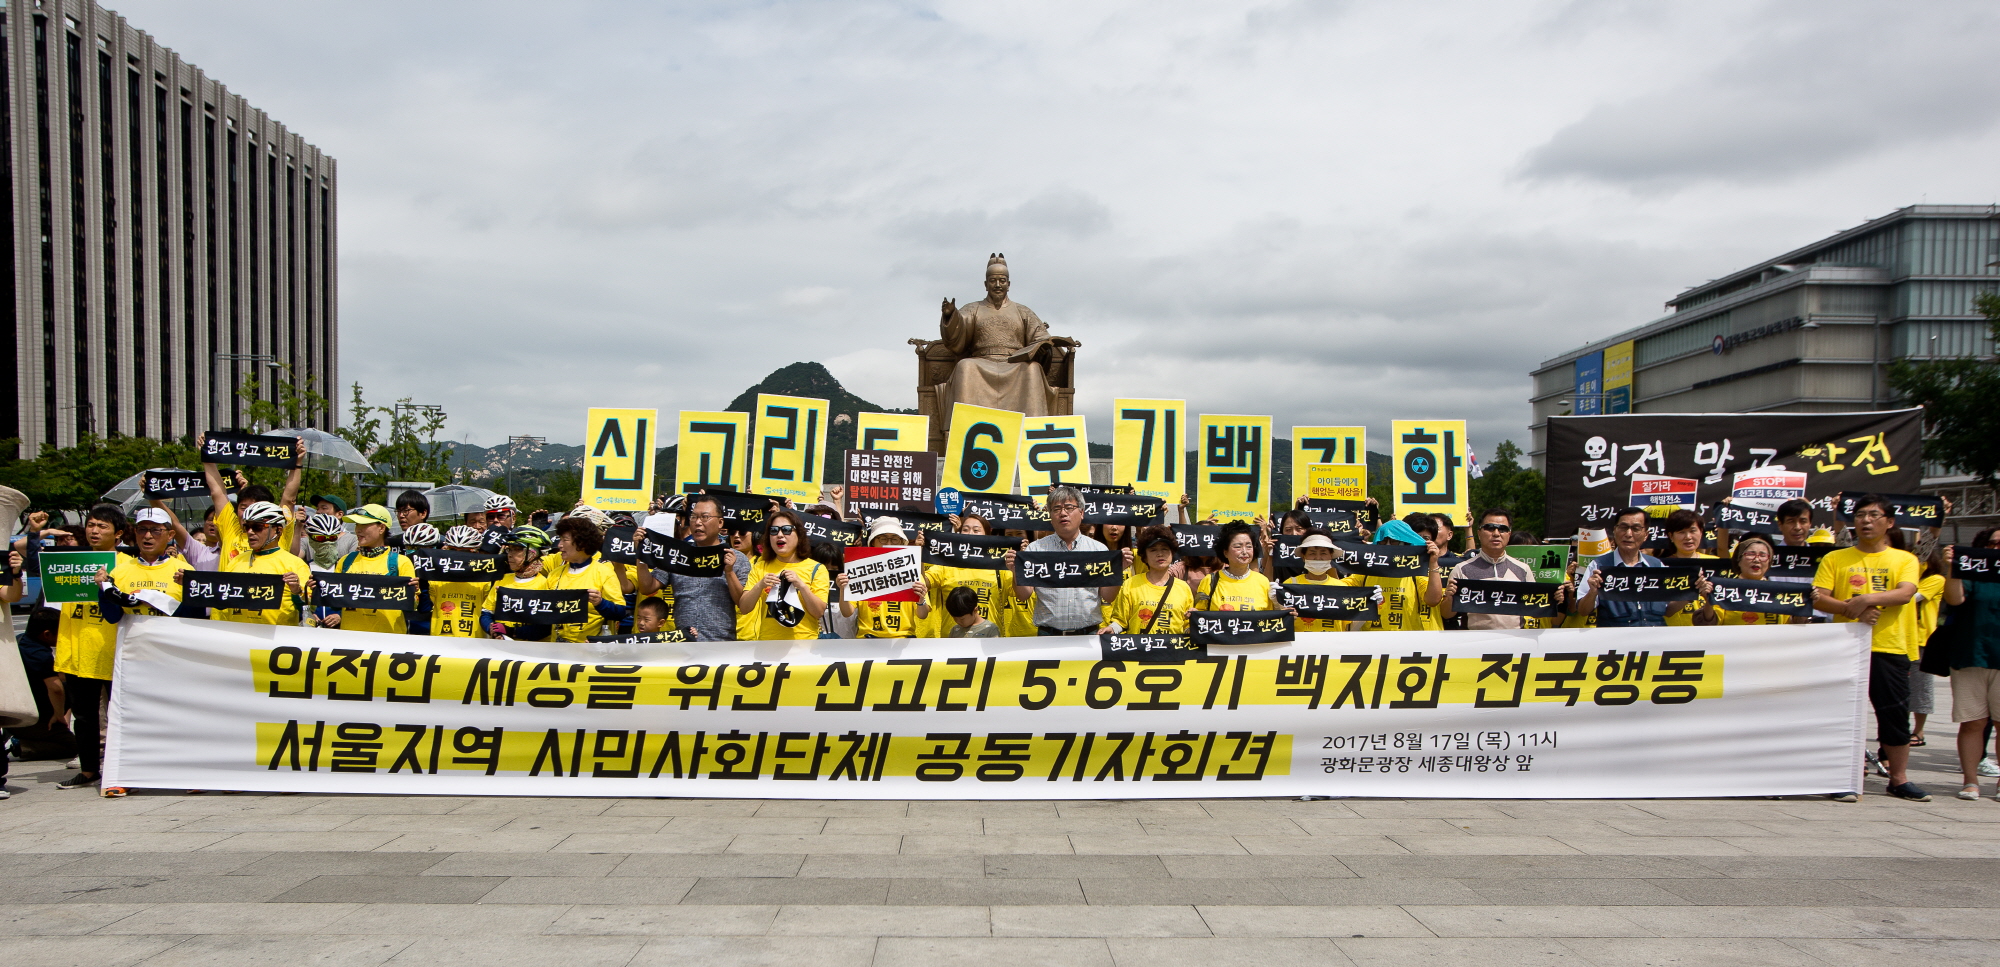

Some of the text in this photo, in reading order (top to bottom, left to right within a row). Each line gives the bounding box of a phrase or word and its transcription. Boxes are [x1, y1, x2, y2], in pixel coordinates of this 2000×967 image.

[208, 439, 290, 459] 원전 말고 안전
[761, 405, 817, 482] 리
[1122, 408, 1175, 483] 기
[592, 418, 647, 489] 신
[683, 421, 737, 492] 고
[851, 454, 913, 468] 불교는 안전한
[960, 422, 1004, 490] 6
[1025, 423, 1078, 496] 호
[1582, 432, 1899, 488] 원전 말고 안전
[1207, 425, 1260, 502] 백
[1402, 428, 1462, 506] 화
[150, 477, 175, 491] 원전
[178, 478, 204, 491] 말고
[850, 470, 922, 485] 대한민국을 위해
[1318, 478, 1358, 486] 아이들에게
[1753, 477, 1785, 486] STOP!
[850, 486, 931, 501] 탈핵에너지 전환을
[1312, 487, 1362, 496] 핵없는 세상을!
[1642, 481, 1671, 492] 잘가라
[939, 492, 959, 504] 탈핵
[1650, 495, 1681, 504] 핵발전소
[739, 508, 764, 522] 안전
[999, 508, 1023, 521] 말고
[1102, 502, 1127, 516] 말고
[1130, 504, 1156, 518] 안전
[1581, 505, 1617, 521] 잘가
[1721, 508, 1771, 525] 원전 말고
[1906, 505, 1937, 518] 안전
[804, 522, 854, 545] 말고 안전
[1327, 520, 1352, 532] 안전
[610, 538, 636, 555] 원전
[1176, 532, 1200, 547] 원전
[642, 538, 721, 568] 원전 말고 안전
[930, 539, 954, 556] 원전
[959, 544, 984, 558] 말고
[48, 564, 73, 574] 신고리
[439, 558, 465, 572] 말고
[468, 559, 497, 572] 안전
[1363, 552, 1420, 569] 말고 안전
[1786, 555, 1811, 569] 말고
[1959, 555, 1989, 572] 원전
[1024, 561, 1051, 578] 원전
[1054, 562, 1081, 579] 말고
[1084, 561, 1114, 577] 안전
[849, 568, 919, 594] 백지화하라!
[1604, 575, 1690, 592] 원전 말고 안전
[190, 580, 275, 600] 원전 말고 안전
[319, 580, 407, 600] 원전 말고 안전
[1460, 587, 1550, 607] 원전 말고 안전
[1714, 585, 1805, 606] 원전 말고 안전
[502, 595, 581, 614] 원전 말고 안전
[1283, 592, 1369, 612] 원전 말고 안전
[1388, 594, 1405, 629] 탈핵
[1198, 618, 1286, 635] 원전 말고 안전
[1110, 636, 1137, 651] 원전
[1141, 637, 1167, 652] 말고
[268, 646, 1706, 712] 안전한 세상을 위한 신고리 5·6호기 백지화 전국행동
[1322, 731, 1558, 752] 2017년 8월 17일 (목) 11시
[268, 719, 1276, 782] 서울지역 시민사회단체 공동기자회견
[1320, 754, 1534, 774] 광화문광장 세종대왕상 앞
